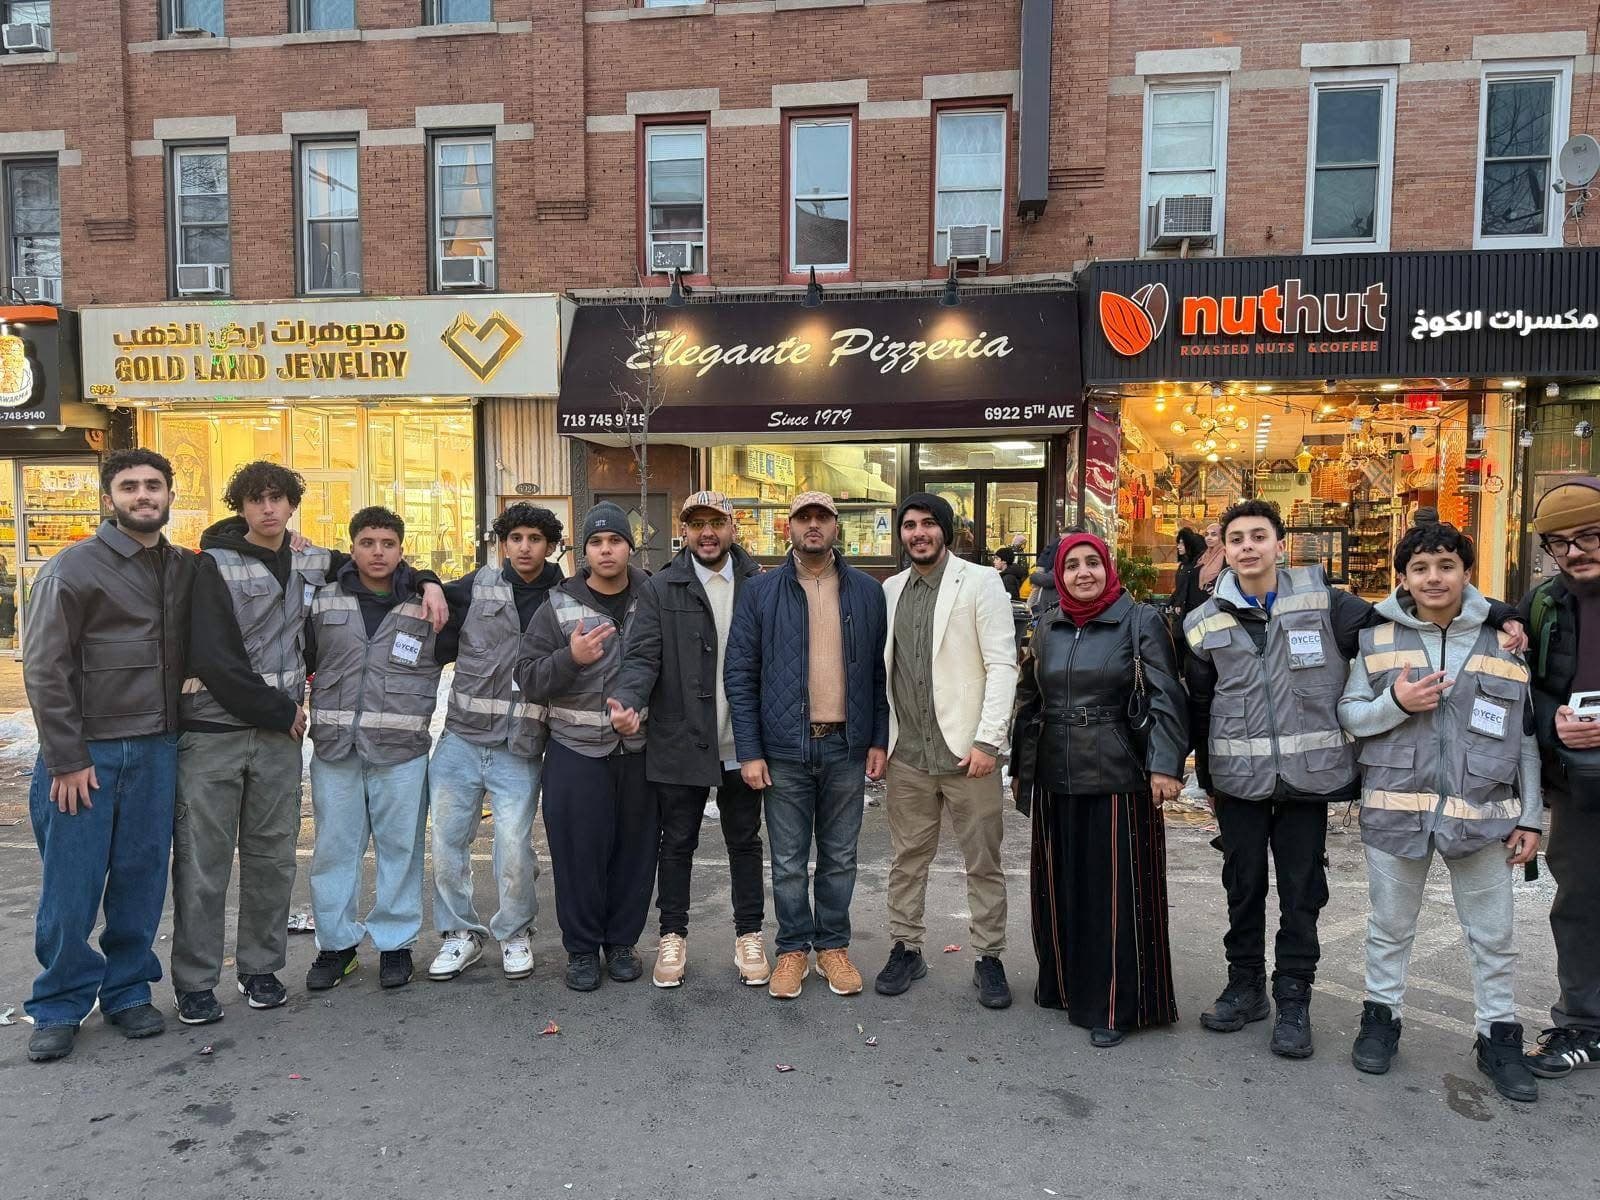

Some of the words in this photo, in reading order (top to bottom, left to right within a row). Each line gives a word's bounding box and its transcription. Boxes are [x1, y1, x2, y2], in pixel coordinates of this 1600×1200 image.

[1182, 279, 1387, 335] nuthut
[271, 320, 406, 347] مجوهرات
[1411, 309, 1482, 340] الكوخ
[1489, 308, 1599, 336] مكسرات
[113, 323, 201, 351] الذهب
[1180, 344, 1249, 356] ROASTED
[1255, 343, 1295, 354] NUTS
[626, 330, 811, 377] Elegante
[830, 328, 1014, 374] Pizzeria
[114, 355, 186, 382] GOLD
[194, 354, 266, 381] LAND
[276, 351, 408, 380] JEWELRY
[562, 414, 586, 426] 718
[589, 414, 612, 426] 745
[768, 411, 808, 428] Since
[814, 408, 852, 425] 1979
[984, 407, 1020, 420] 6922
[1024, 405, 1045, 419] 5TH
[1048, 405, 1075, 418] AVE
[876, 516, 888, 529] A
